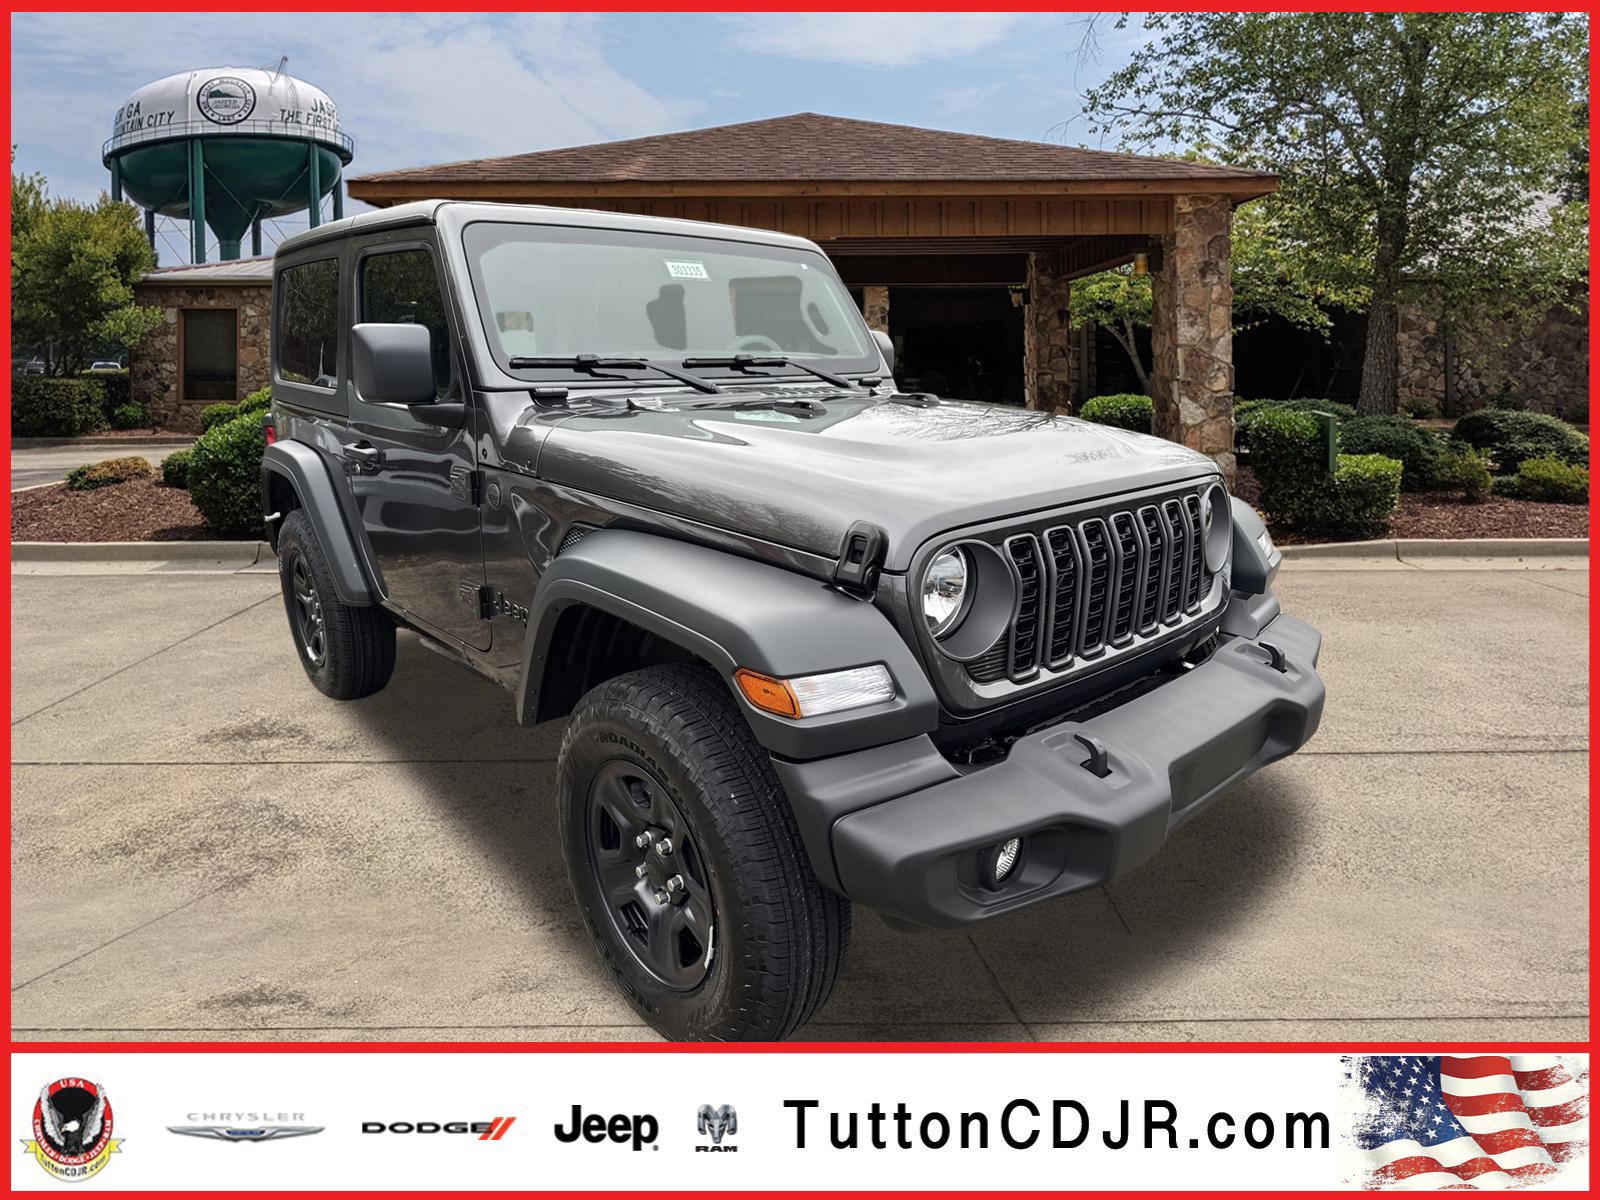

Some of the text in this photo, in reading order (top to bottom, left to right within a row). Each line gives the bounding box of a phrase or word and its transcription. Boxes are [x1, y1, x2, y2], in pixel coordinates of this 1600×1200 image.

[126, 101, 140, 119] GA
[147, 110, 175, 127] CITY
[280, 109, 302, 124] THE
[306, 112, 332, 130] FIRST
[311, 98, 340, 121] JASP
[492, 591, 530, 628] Jeep
